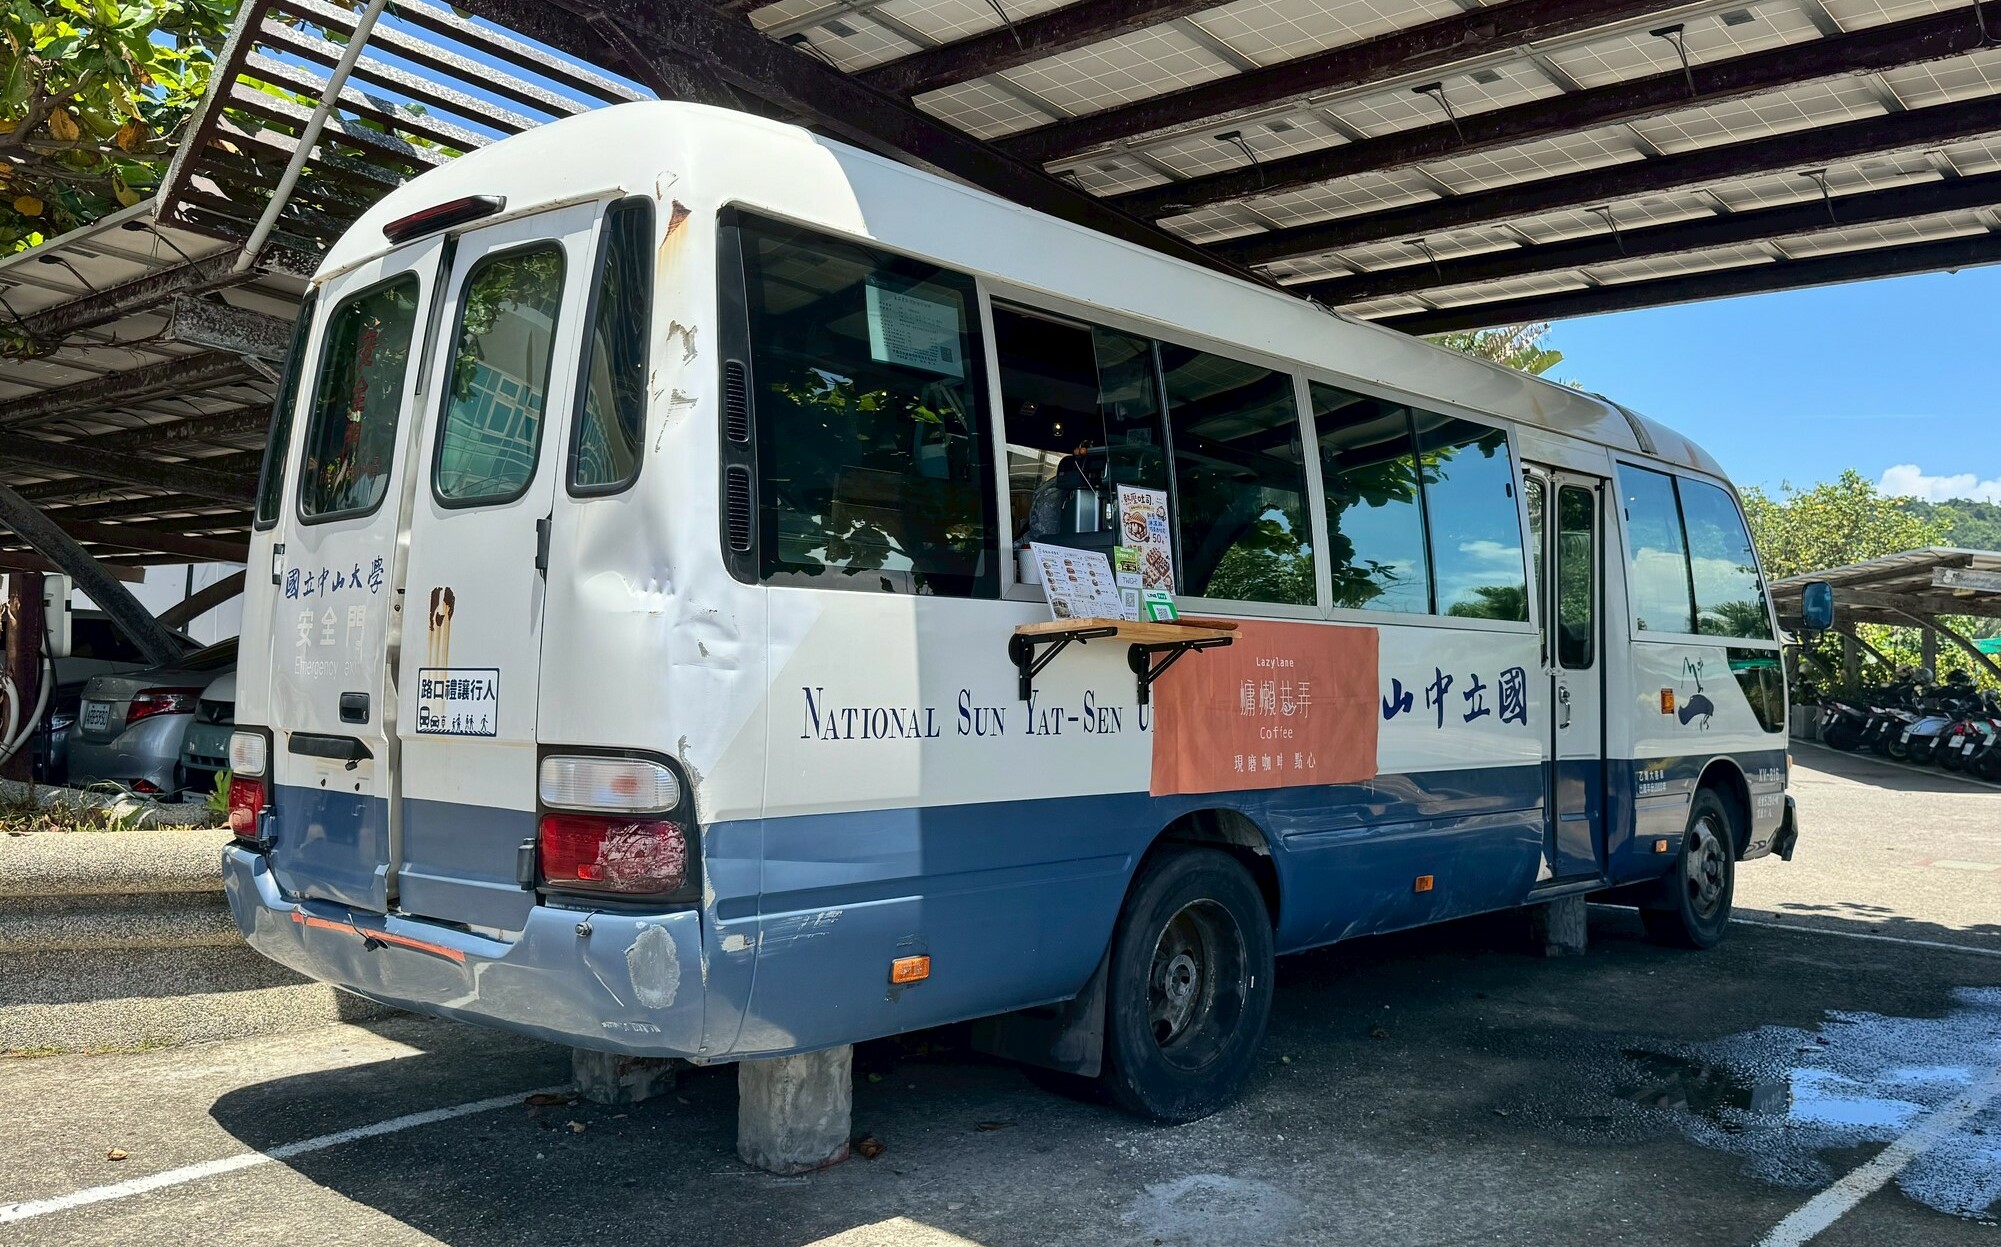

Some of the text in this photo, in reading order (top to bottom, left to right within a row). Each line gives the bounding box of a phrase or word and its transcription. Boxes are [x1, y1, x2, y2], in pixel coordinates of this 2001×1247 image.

[285, 554, 384, 600] 國立中山大學
[296, 605, 366, 661] 安全門
[295, 656, 337, 680] Emergency
[1256, 657, 1294, 669] Lazylane
[421, 679, 495, 701] 路口禮讓行人
[1240, 679, 1312, 719] 慵懶巷弄
[800, 687, 941, 740] NATIONAL
[957, 689, 1006, 736] SUN
[1259, 726, 1293, 739] Coffee
